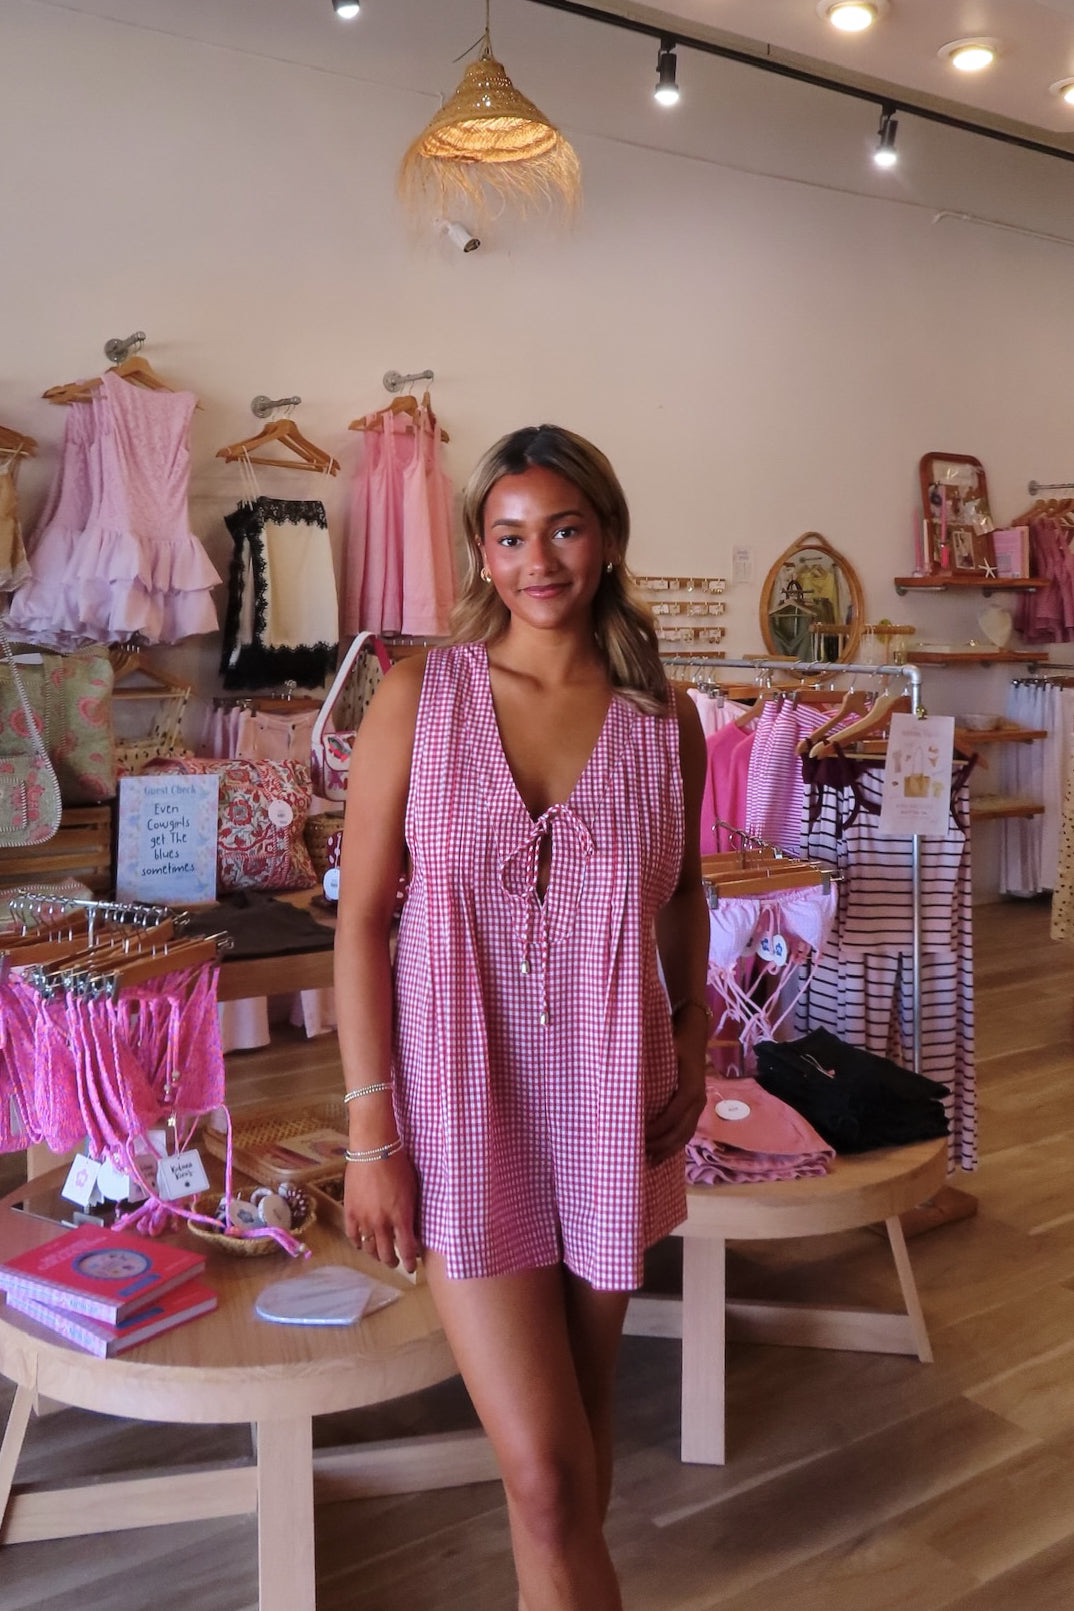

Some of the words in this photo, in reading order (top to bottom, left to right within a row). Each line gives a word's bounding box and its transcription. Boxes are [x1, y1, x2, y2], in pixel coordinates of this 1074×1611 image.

[154, 803, 179, 815] Even
[147, 816, 190, 832] Cowgirls
[150, 834, 165, 848] get
[170, 832, 187, 843] The
[154, 849, 179, 860] blues
[141, 862, 195, 876] sometimes
